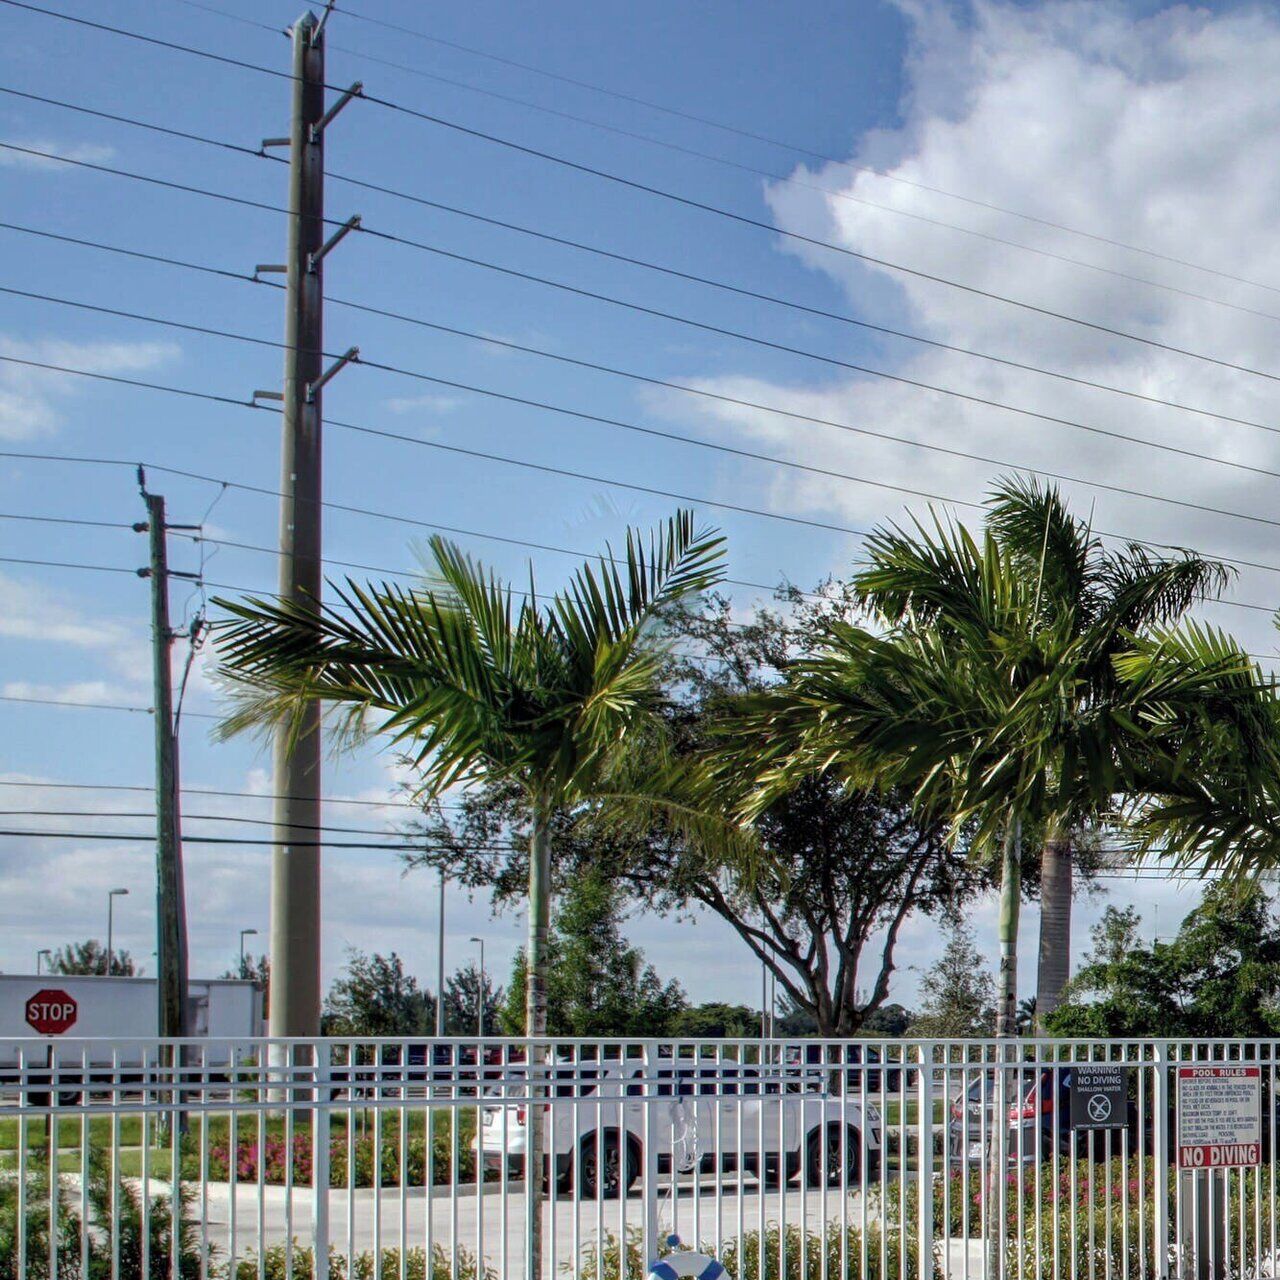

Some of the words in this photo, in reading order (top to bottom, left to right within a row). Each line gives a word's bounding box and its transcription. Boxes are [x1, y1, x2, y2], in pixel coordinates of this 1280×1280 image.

[28, 1003, 75, 1021] STOP
[1077, 1066, 1121, 1074] WARNING!
[1192, 1069, 1216, 1077] POOL
[1219, 1069, 1247, 1077] RULES
[1077, 1076, 1091, 1085] NO
[1092, 1076, 1122, 1085] DIVING
[1183, 1147, 1204, 1167] NO
[1210, 1145, 1257, 1165] DIVING
